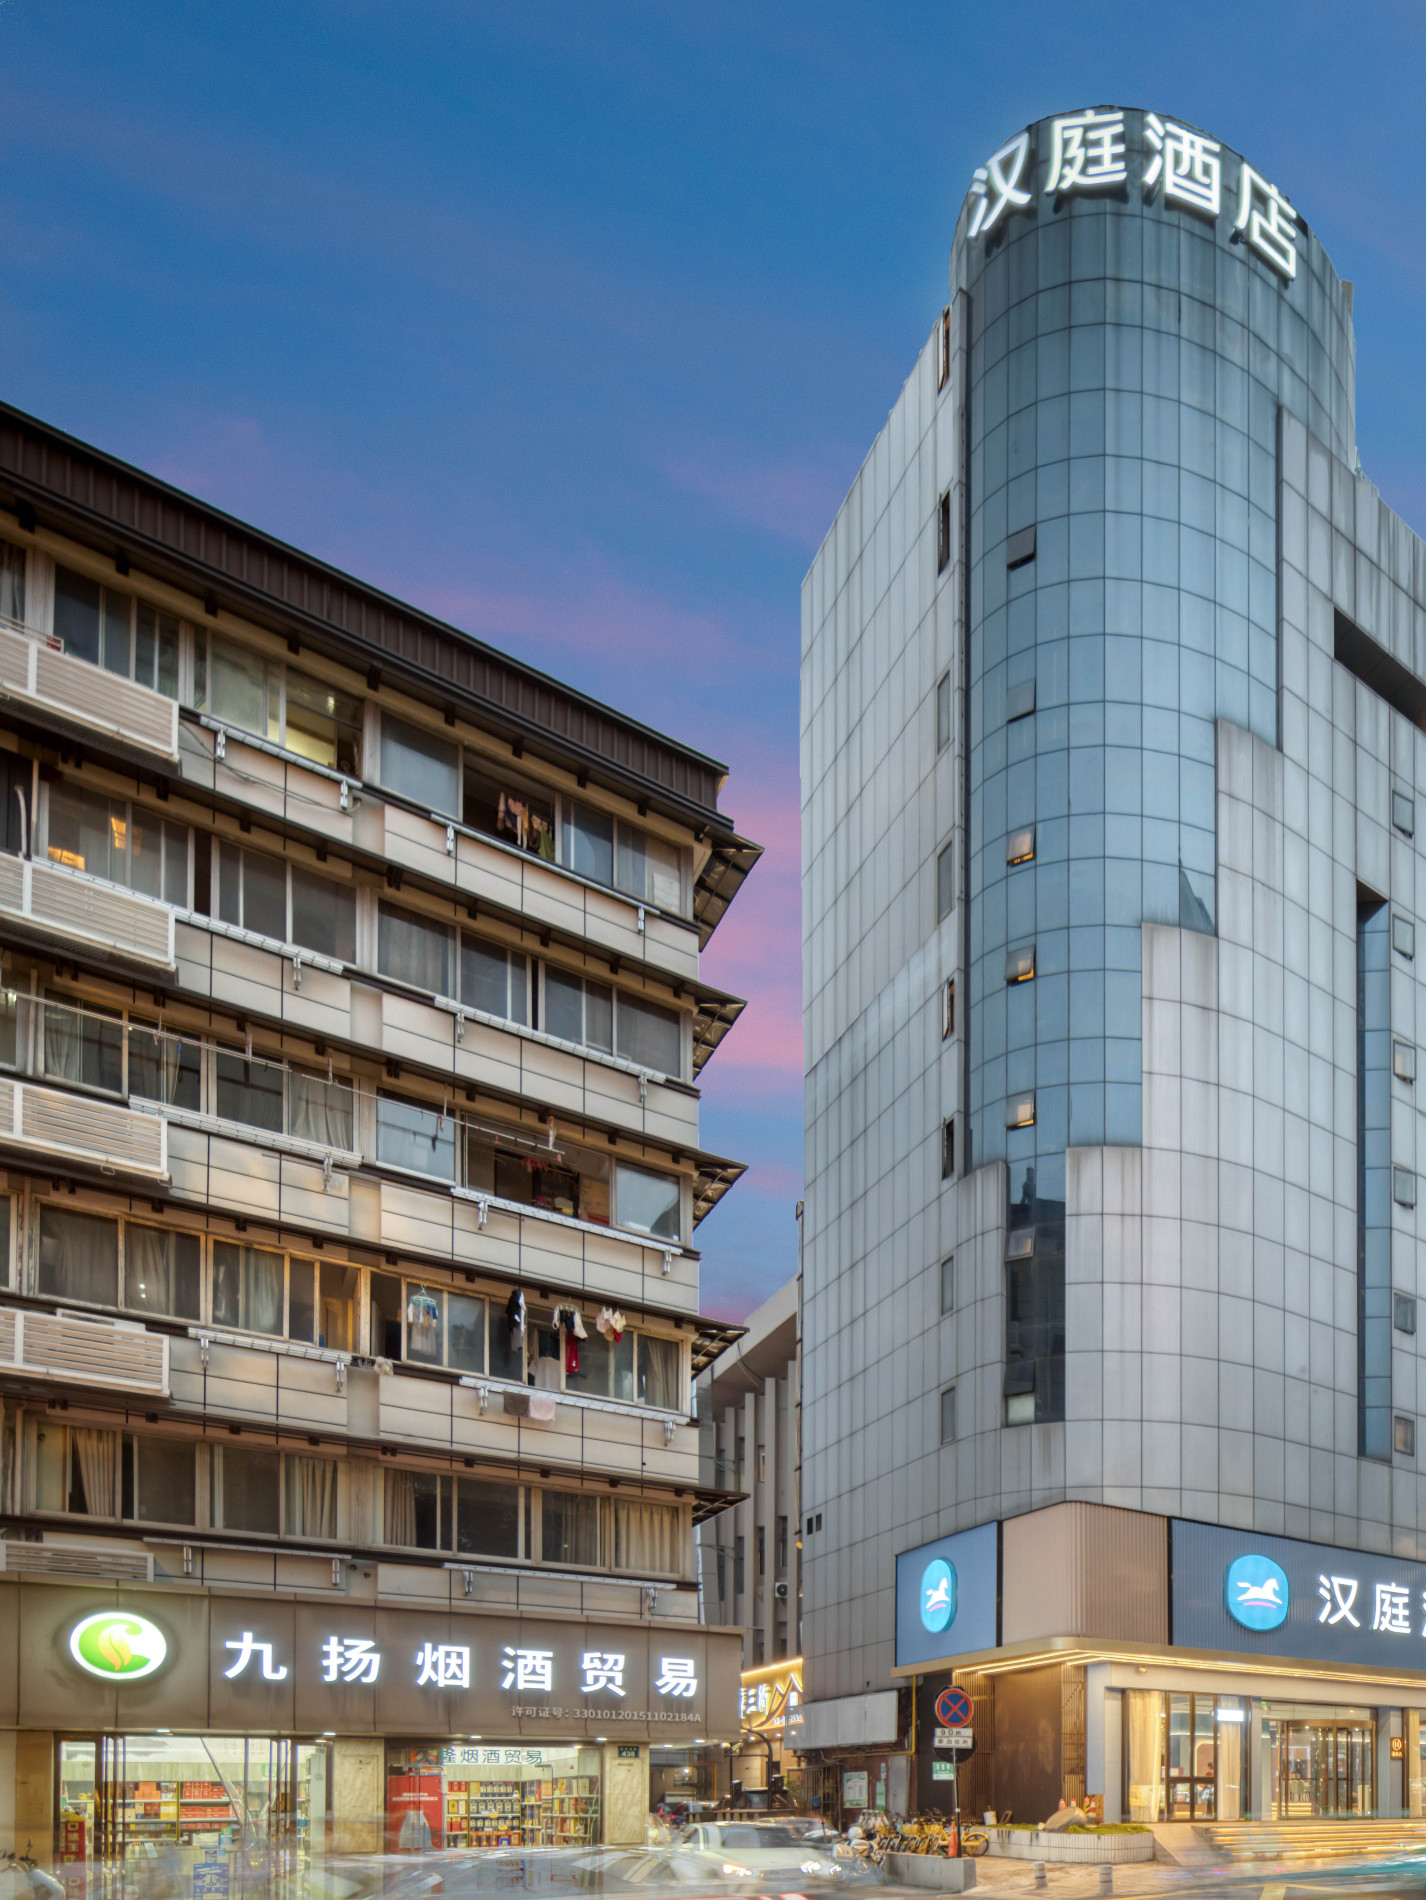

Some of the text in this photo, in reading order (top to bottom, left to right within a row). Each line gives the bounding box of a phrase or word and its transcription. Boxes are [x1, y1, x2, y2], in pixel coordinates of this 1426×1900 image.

[967, 110, 1297, 280] 汉庭酒店
[224, 1631, 698, 1697] 九扬烟酒贸易
